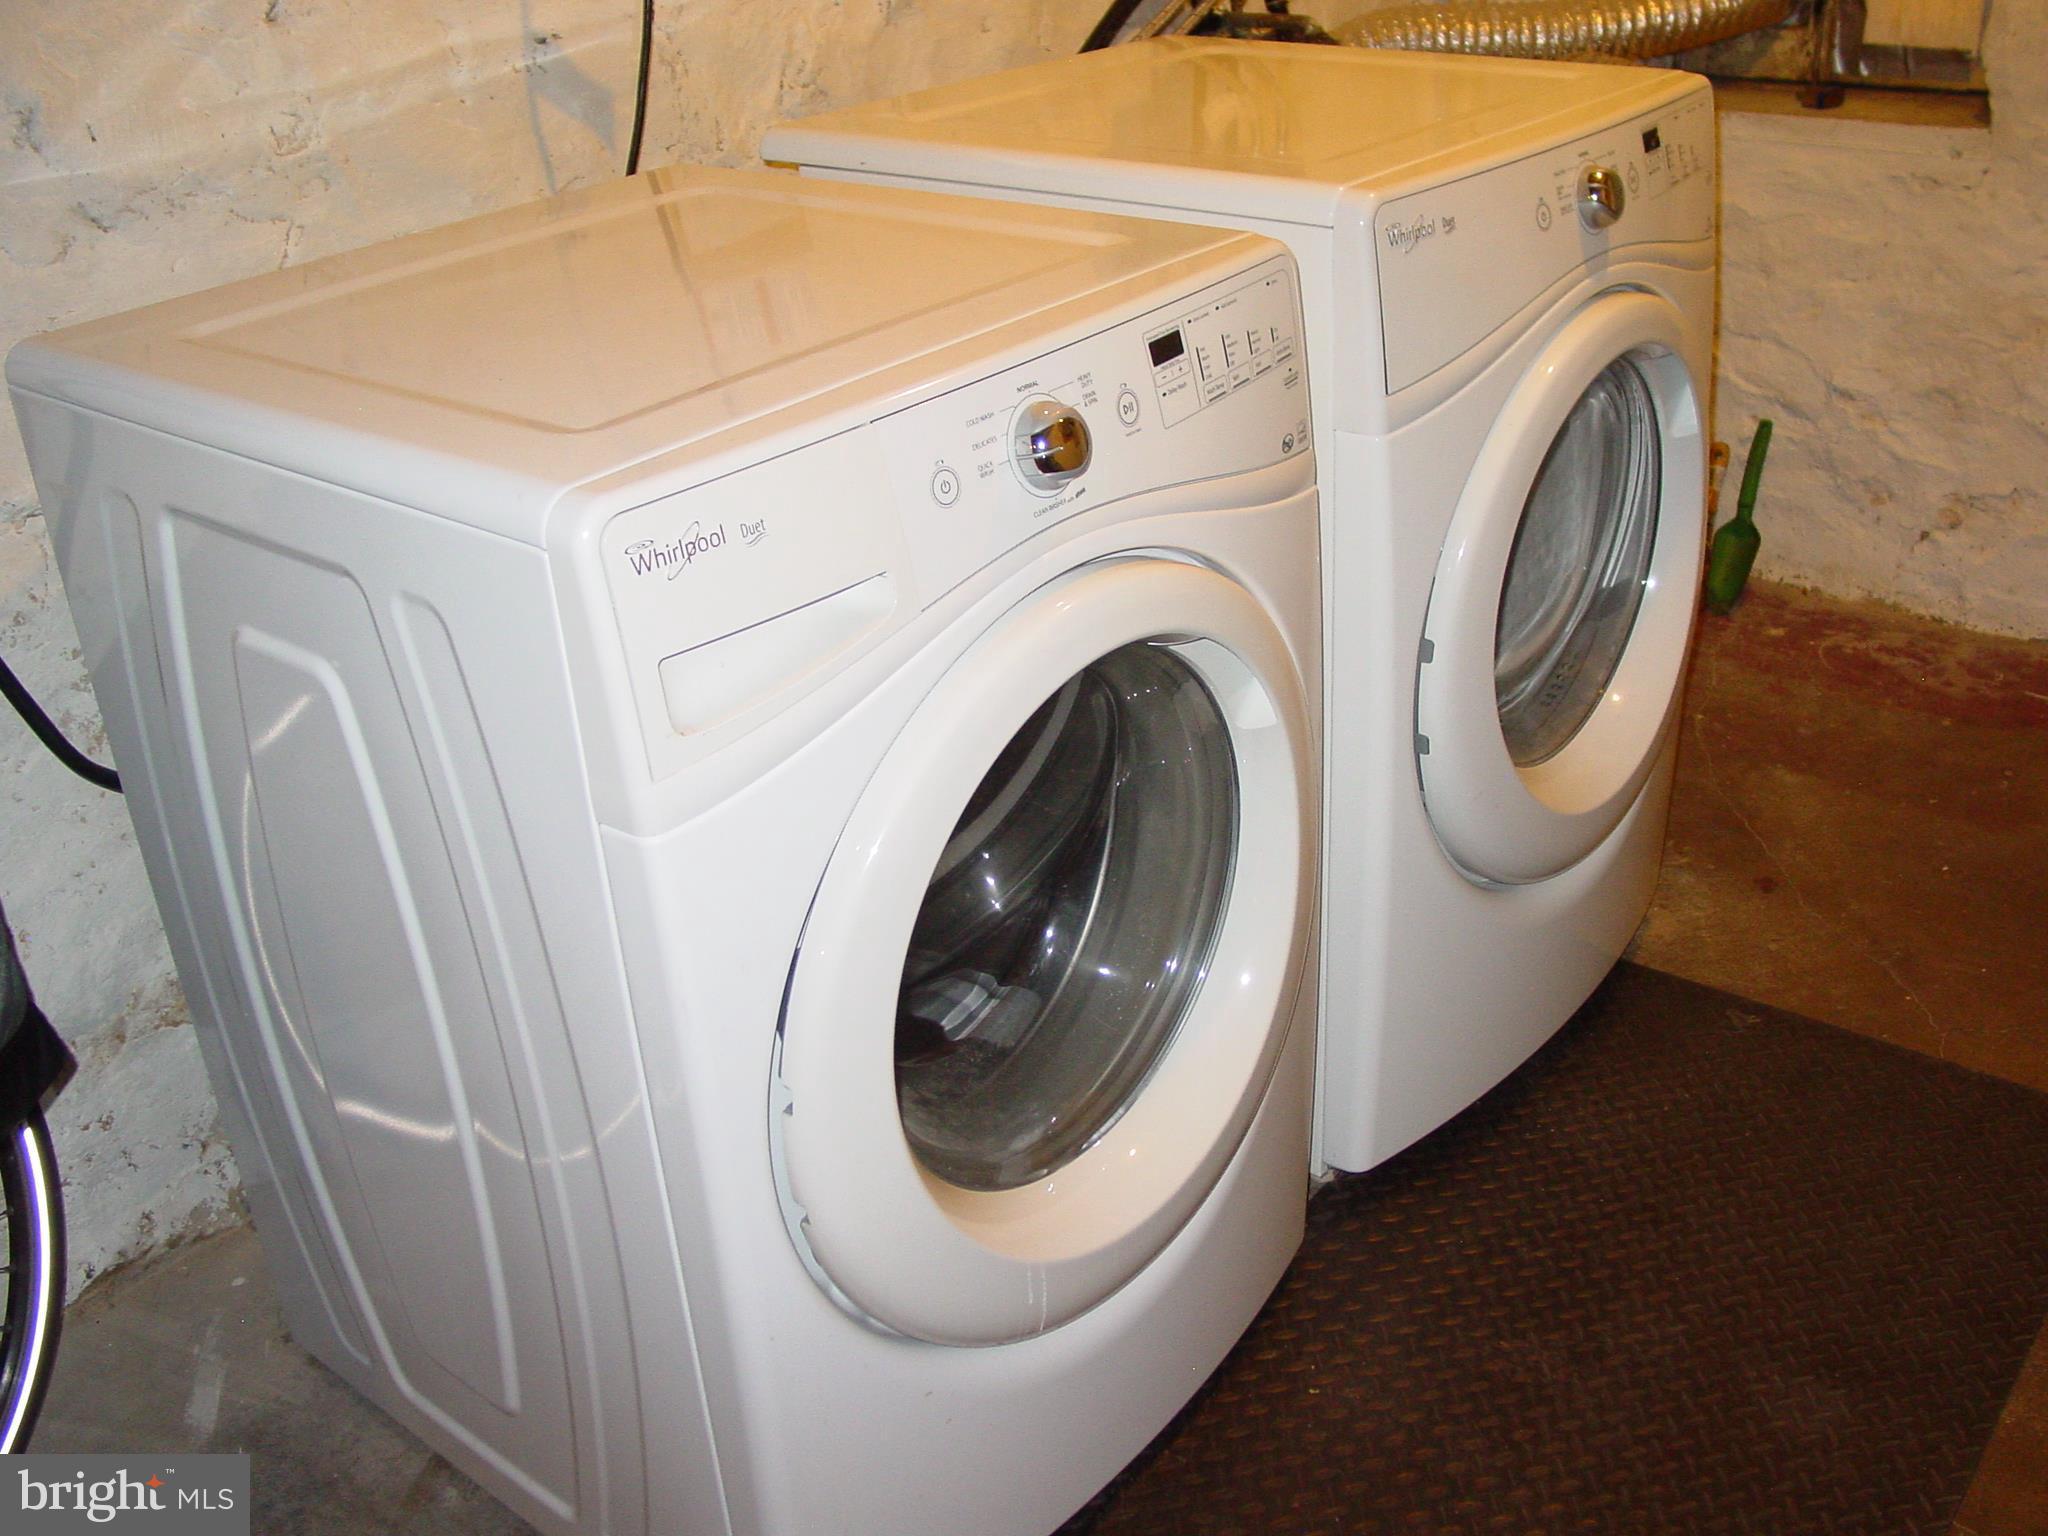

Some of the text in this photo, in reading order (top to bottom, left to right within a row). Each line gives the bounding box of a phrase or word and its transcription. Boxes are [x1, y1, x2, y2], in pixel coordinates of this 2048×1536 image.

[1386, 216, 1436, 251] Whirlpool
[1016, 380, 1039, 393] NORMAL
[966, 411, 995, 427] COLD WASH
[1033, 506, 1049, 519] CLEAN
[628, 518, 767, 580] Whirlpool Duet
